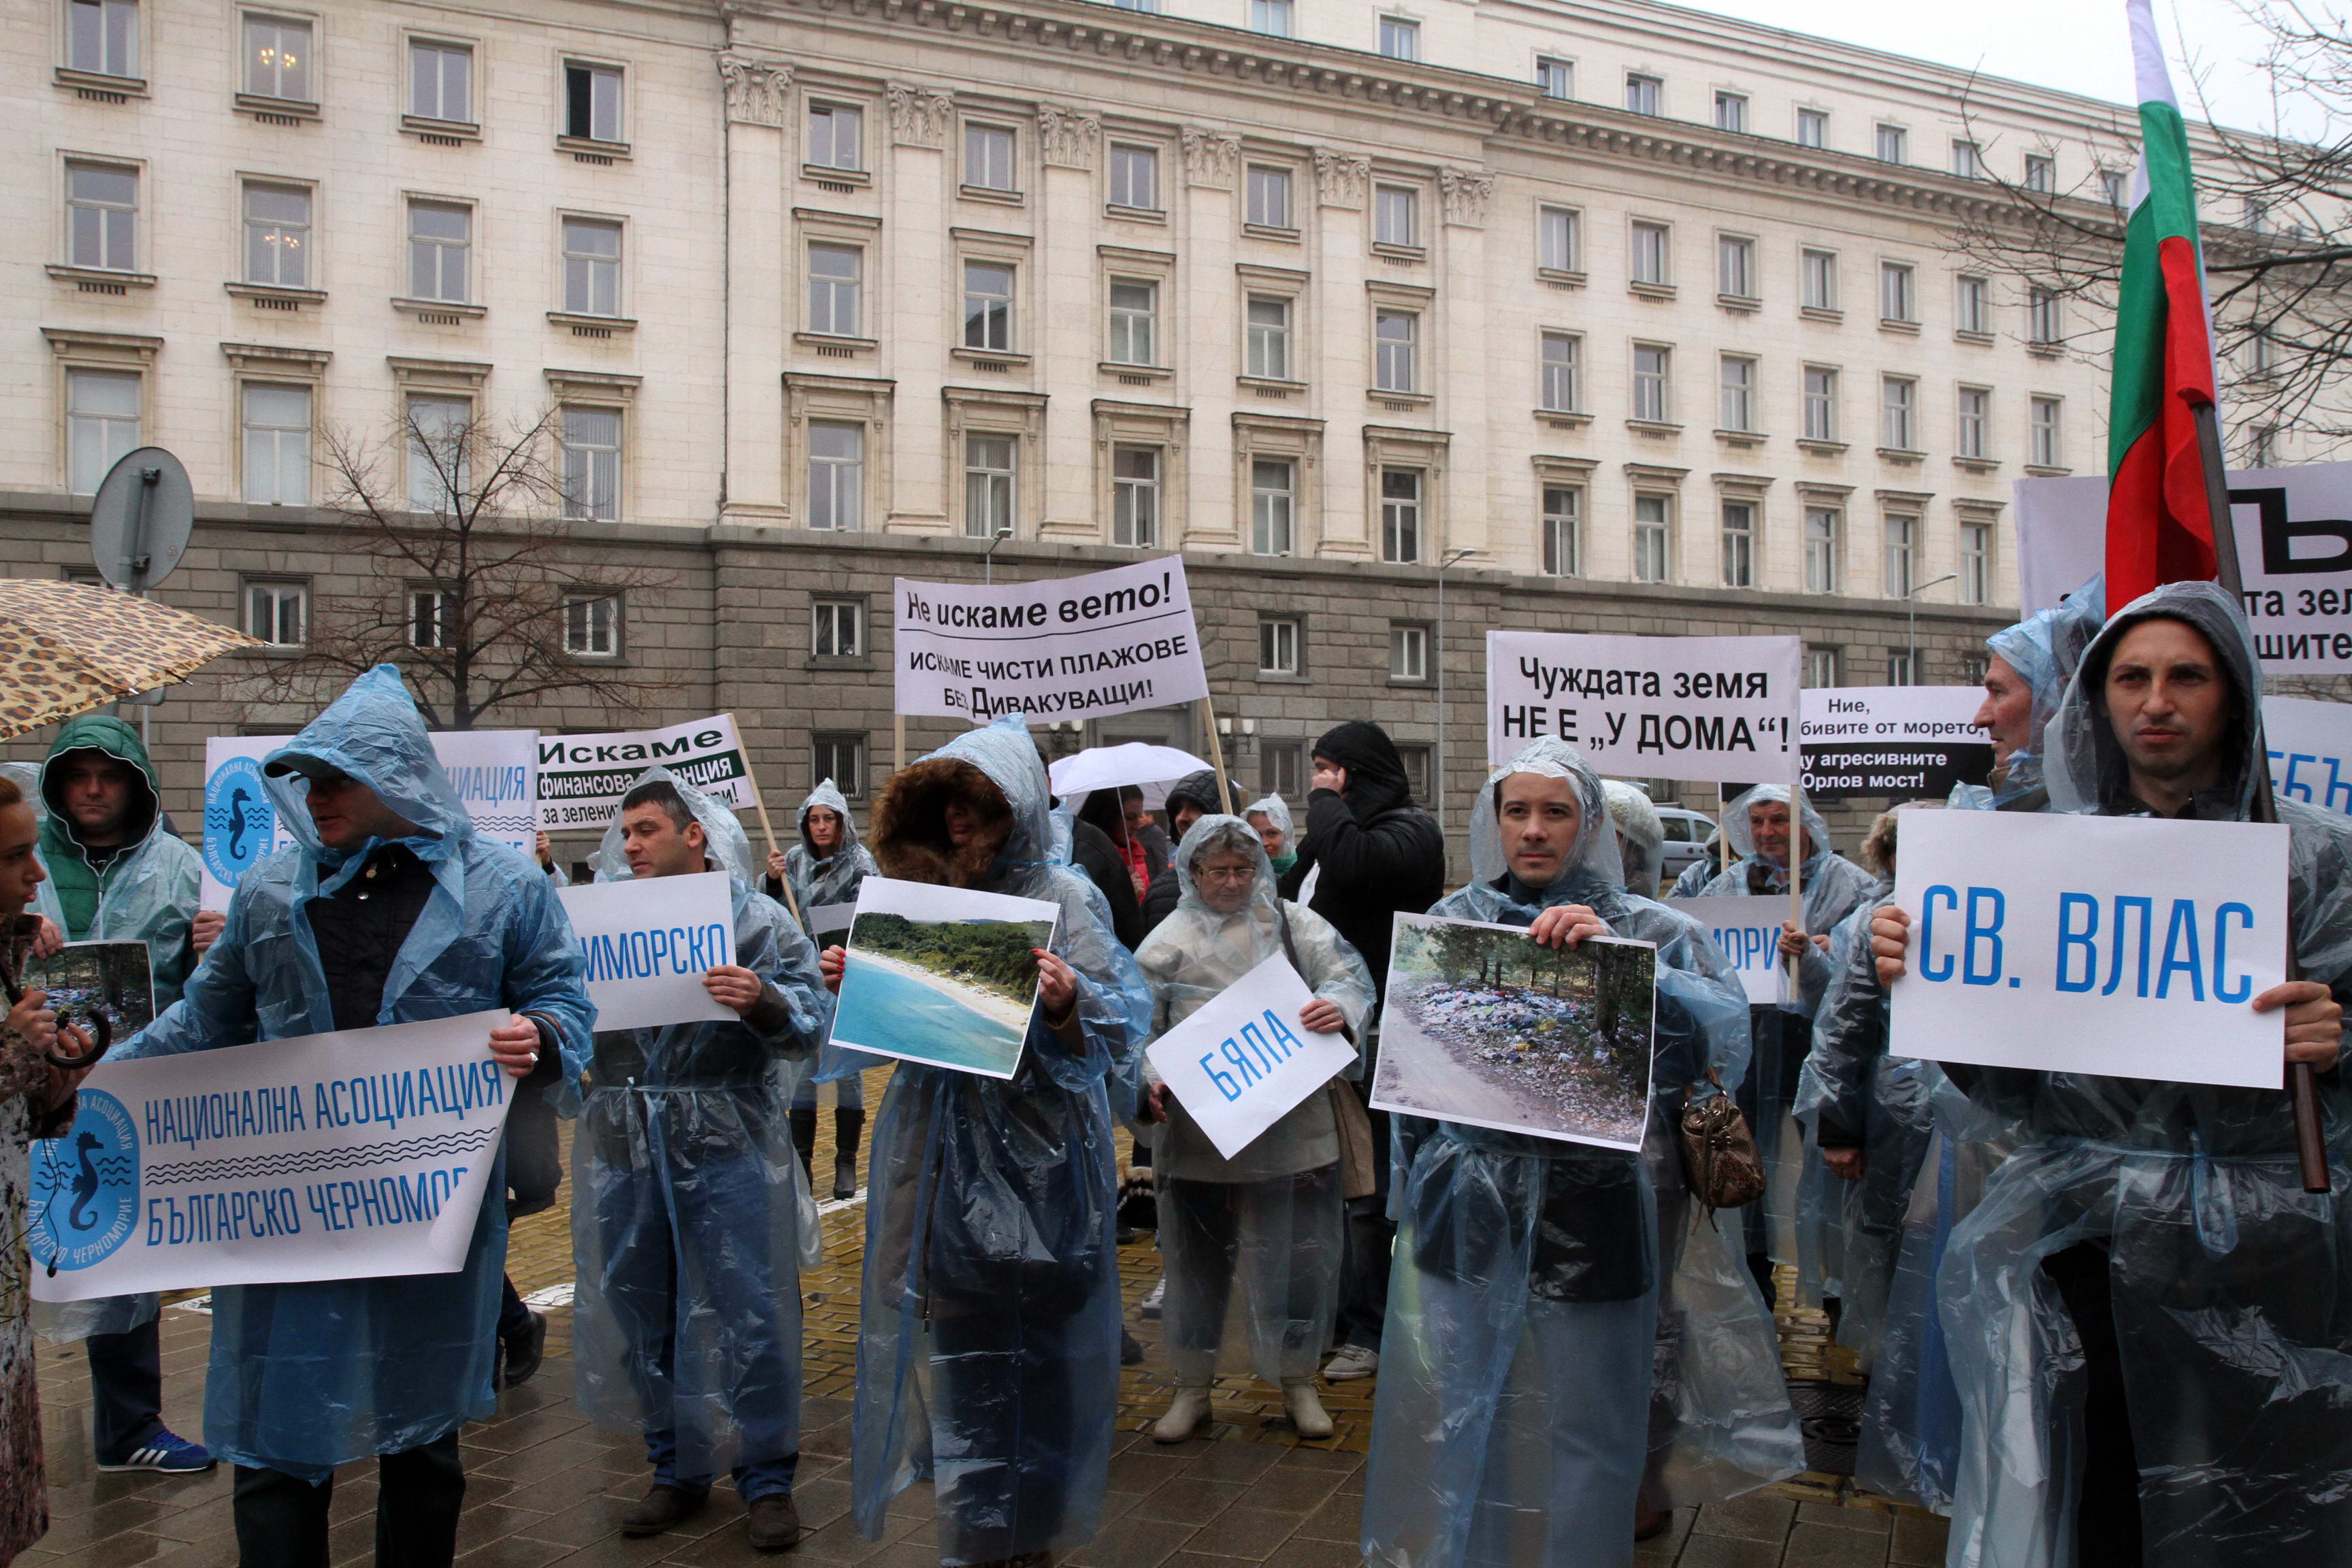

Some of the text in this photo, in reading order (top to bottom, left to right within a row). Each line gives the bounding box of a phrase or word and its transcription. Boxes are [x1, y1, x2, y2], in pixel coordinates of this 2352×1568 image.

[907, 572, 1170, 628] Не искаме вето!
[911, 635, 1188, 680] ИСКАМЕ ЧИСТИ ПЛАЖОВЕ
[1520, 657, 1767, 700] Чуждата земя
[944, 680, 1154, 720] БЕЗ ДИВАКУВАЩИ!
[1829, 698, 1870, 715] Ние,
[1504, 705, 1548, 738] НЕ
[1559, 708, 1578, 742] Е
[1876, 722, 1897, 734] от
[1904, 722, 1984, 737] морето,
[539, 730, 723, 765] Искаме
[1820, 753, 1947, 769] агресивните
[207, 762, 242, 804] НАЦИОНАЛНА
[540, 772, 634, 800] финансова
[1801, 772, 1925, 792] Орлов мост!
[543, 807, 559, 824] за
[207, 837, 233, 883] БЪЛГАРСКО
[1918, 885, 2254, 1004] СВ. ВЛАС
[1199, 1009, 1303, 1102] БЯЛА
[90, 1095, 133, 1150] АСОЦИАЦИЯ
[145, 1060, 504, 1150] НАЦИОНАЛНА АСОЦИАЦИЯ
[74, 1196, 132, 1264] ЧЕРНОМОРИЕ
[146, 1188, 301, 1246] БЪЛГАРСКО
